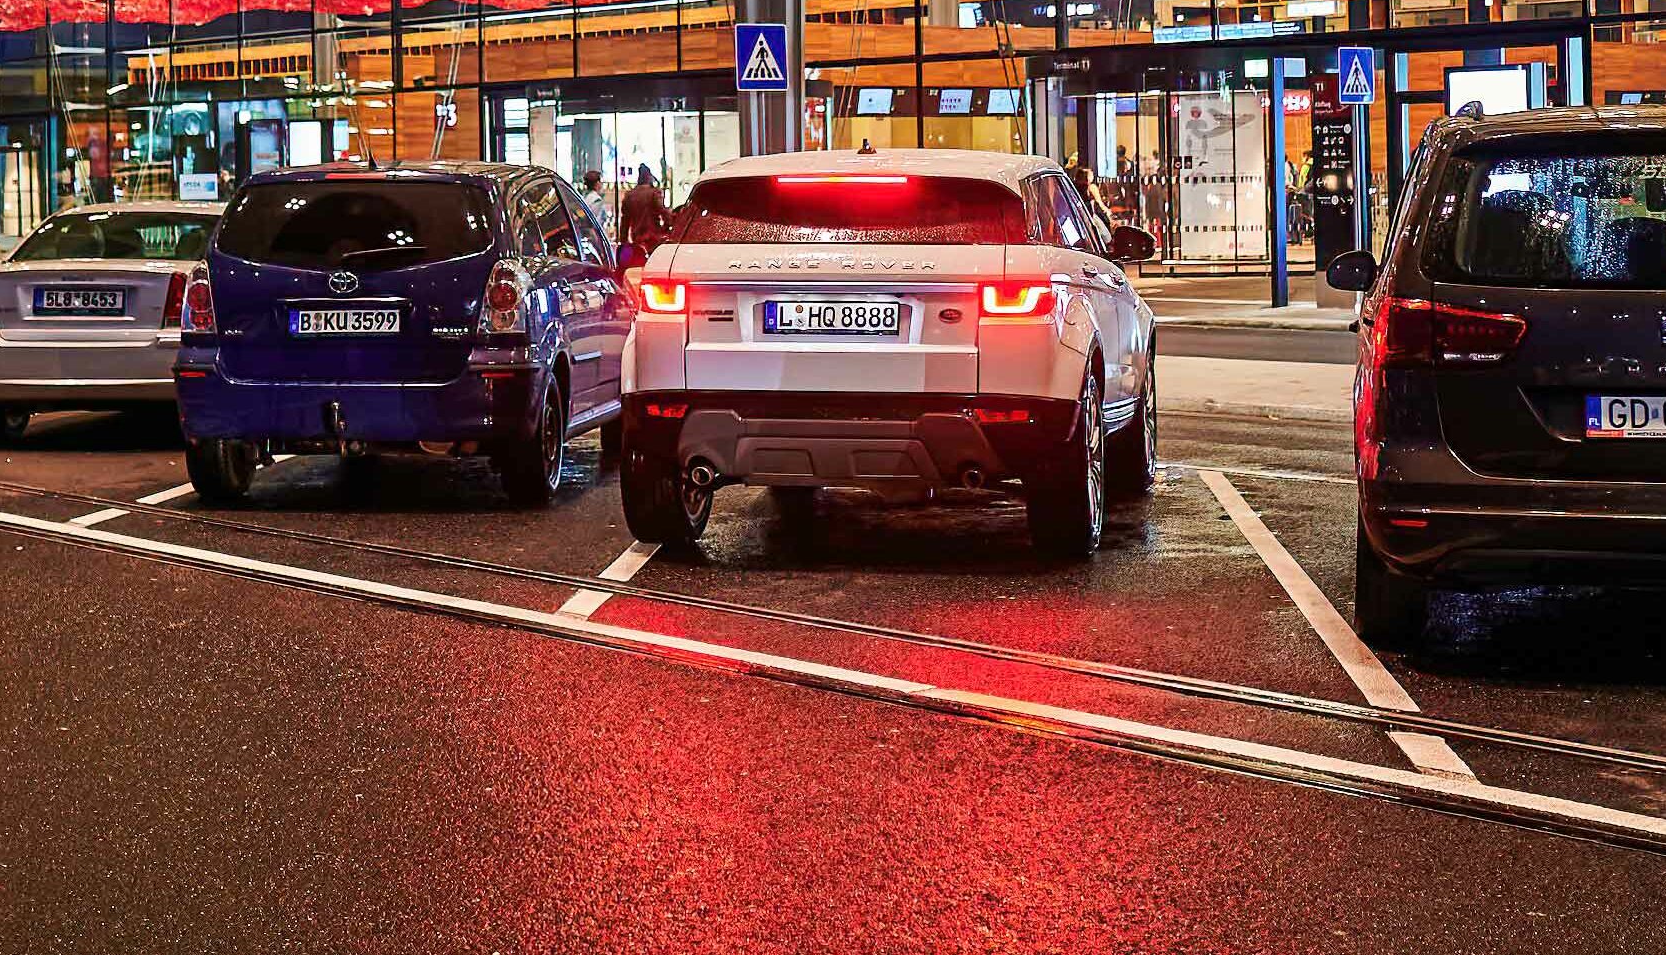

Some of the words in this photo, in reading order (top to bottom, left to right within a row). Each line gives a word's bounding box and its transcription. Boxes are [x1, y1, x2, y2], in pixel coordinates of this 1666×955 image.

[728, 259, 821, 270] RANGE
[841, 259, 936, 270] ROVER
[82, 292, 117, 308] 8453
[299, 312, 312, 331] B
[322, 311, 348, 331] KU
[351, 311, 399, 331] 3599
[779, 306, 792, 328] L
[808, 306, 836, 329] HQ
[841, 306, 896, 328] 8888
[1608, 398, 1650, 430] GD
